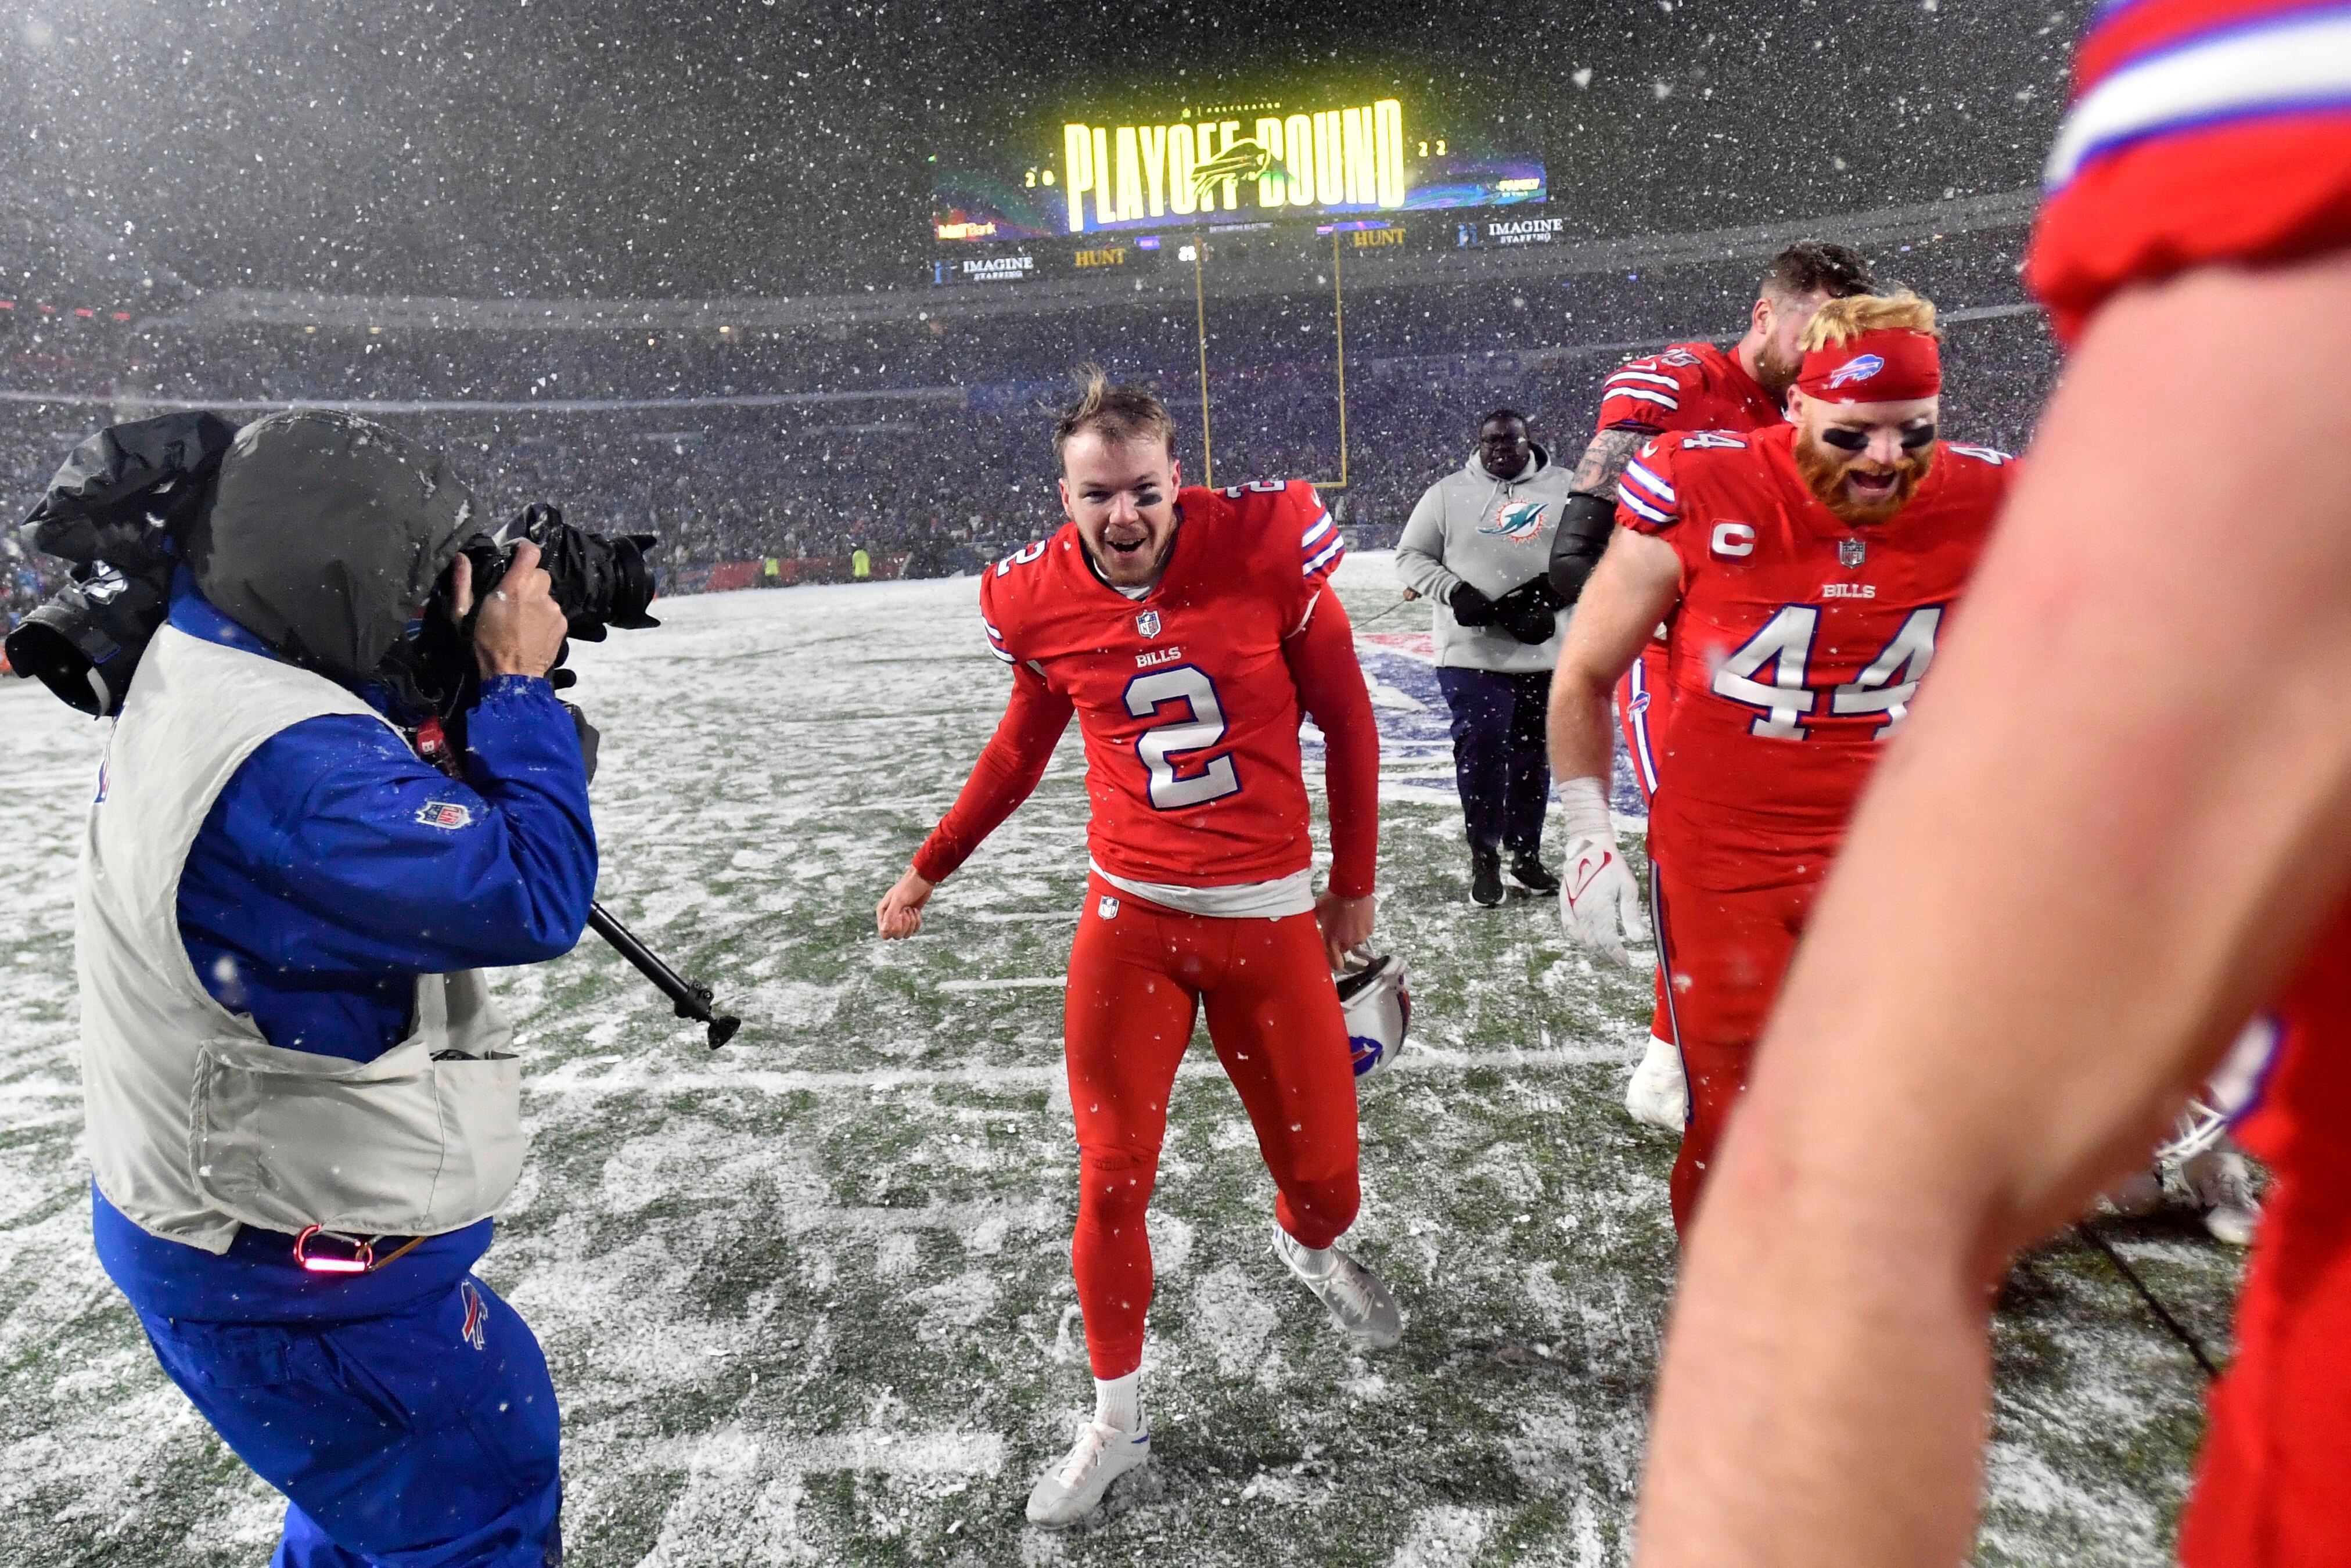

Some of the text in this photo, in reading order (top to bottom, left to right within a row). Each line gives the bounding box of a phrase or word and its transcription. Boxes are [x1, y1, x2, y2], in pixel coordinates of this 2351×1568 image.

[1064, 120, 1241, 231] PLAYOFF
[1354, 228, 1406, 247] HUNT
[1489, 218, 1563, 236] IMAGINE
[963, 256, 1033, 274] IMAGINE
[1076, 248, 1126, 267] HUNT
[1711, 523, 1755, 556] C
[997, 540, 1047, 578] 2
[1822, 584, 1876, 599] BILLS
[1135, 646, 1182, 668] BILLS
[1710, 602, 1946, 741] 44
[1121, 662, 1242, 810] 2
